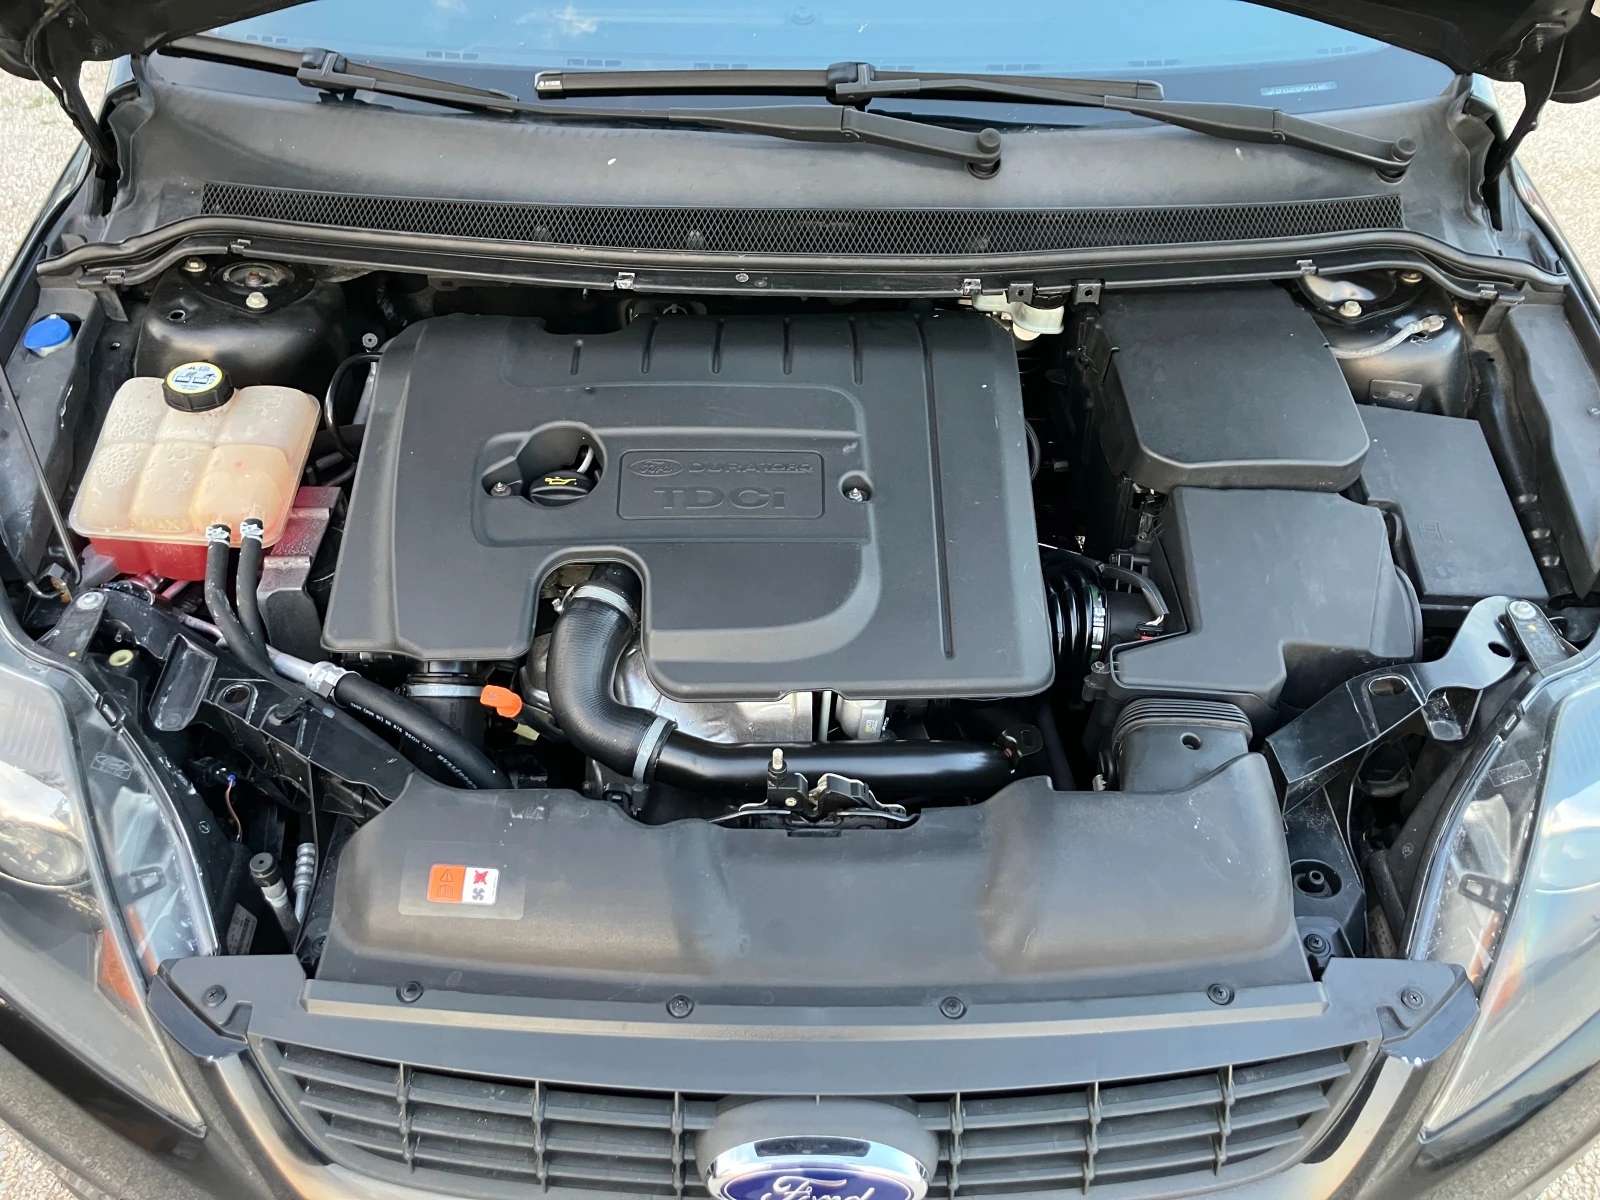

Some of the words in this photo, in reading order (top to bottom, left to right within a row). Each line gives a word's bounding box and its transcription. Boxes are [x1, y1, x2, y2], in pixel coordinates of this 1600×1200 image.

[639, 460, 674, 475] Ford
[688, 462, 813, 474] DURATORQ
[654, 487, 786, 510] TDCi
[153, 544, 183, 554] MIN
[404, 731, 420, 743] HOSE
